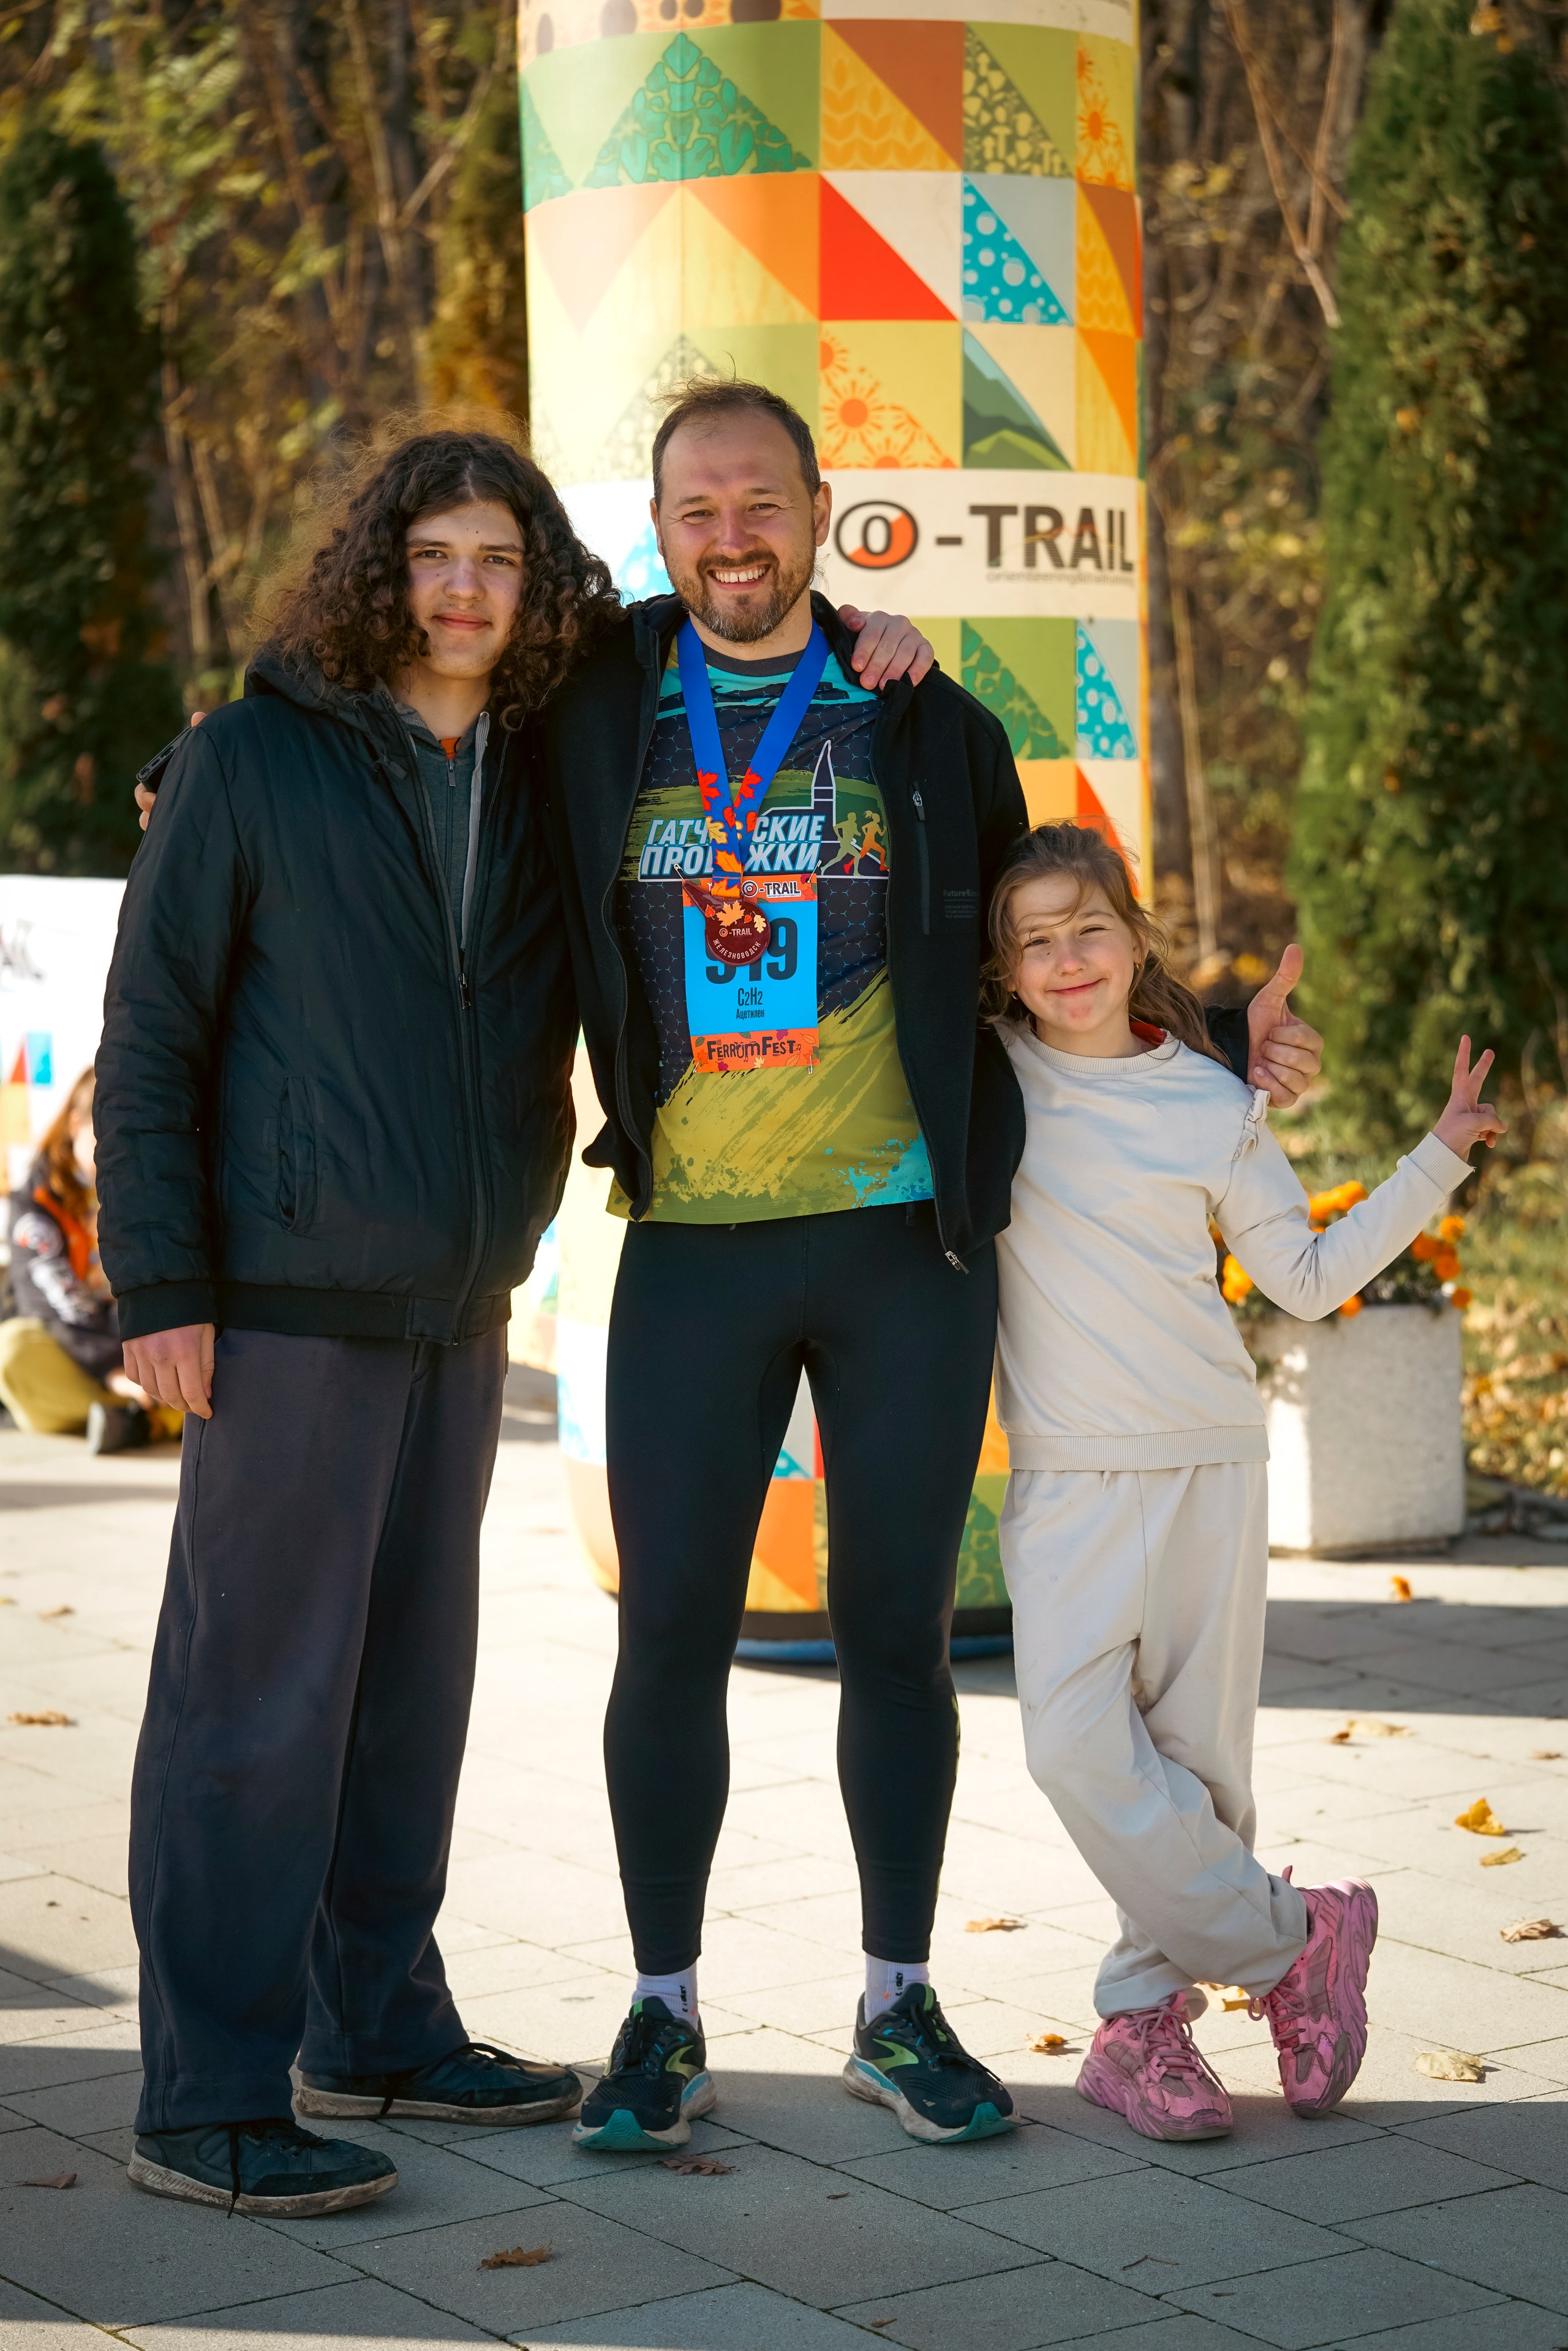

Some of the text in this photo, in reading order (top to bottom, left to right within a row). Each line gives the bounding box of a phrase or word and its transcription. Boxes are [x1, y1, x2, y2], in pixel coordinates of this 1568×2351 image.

[647, 815, 826, 846] ГАТЧСКИЕ
[640, 842, 821, 875] ПРОЖКИ
[713, 938, 761, 959] ЖЕЛЕЗНОВОДСК
[736, 1008, 765, 1020] Ацетилен
